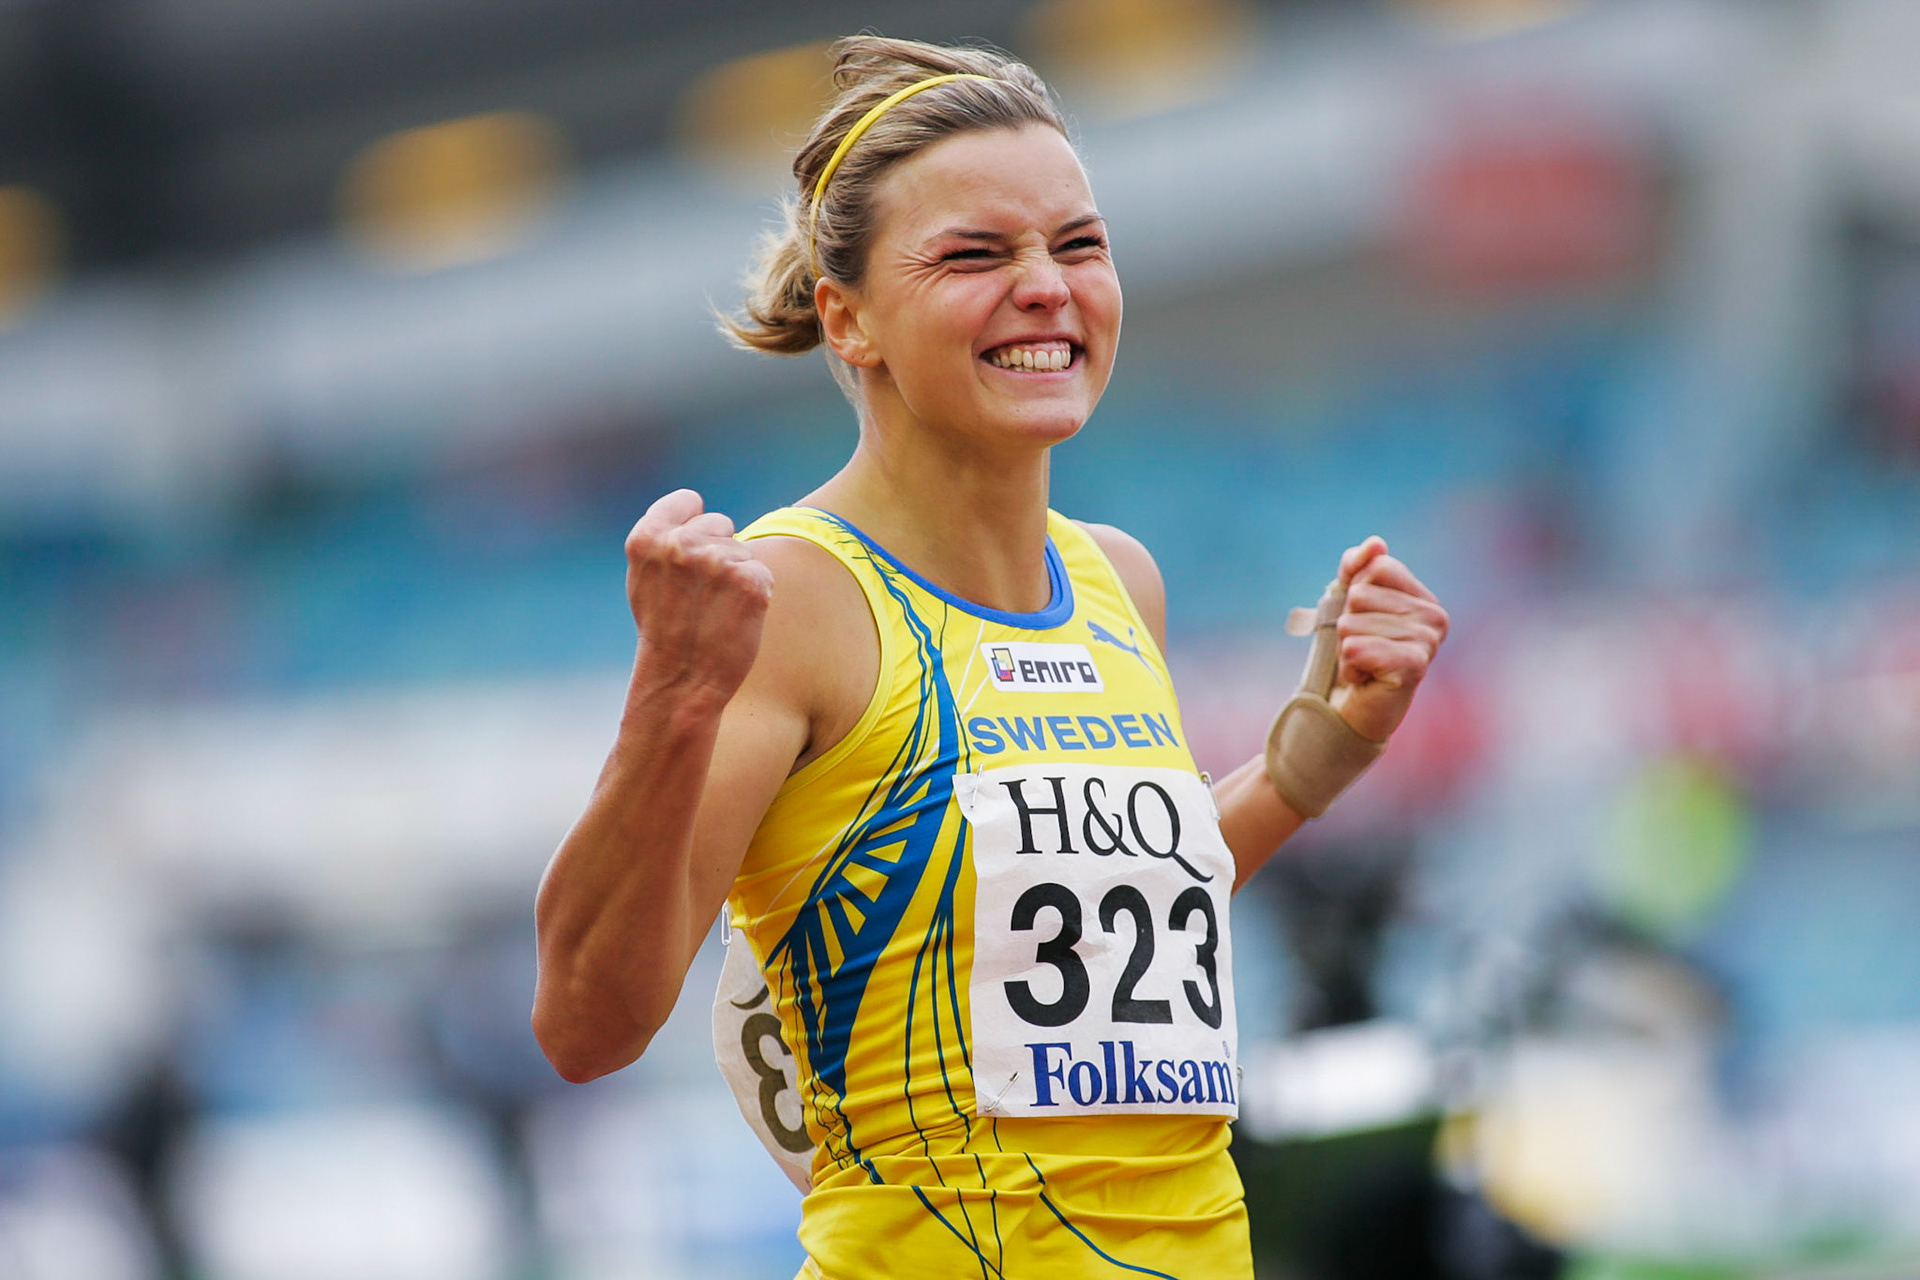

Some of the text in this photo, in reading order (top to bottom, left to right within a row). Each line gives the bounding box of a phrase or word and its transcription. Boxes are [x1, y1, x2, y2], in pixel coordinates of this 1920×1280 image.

[1018, 660, 1098, 684] eniro
[967, 712, 1180, 755] SWEDEN
[998, 776, 1214, 883] H&Q
[1003, 882, 1222, 1030] 323
[1024, 1040, 1237, 1107] Folksam
